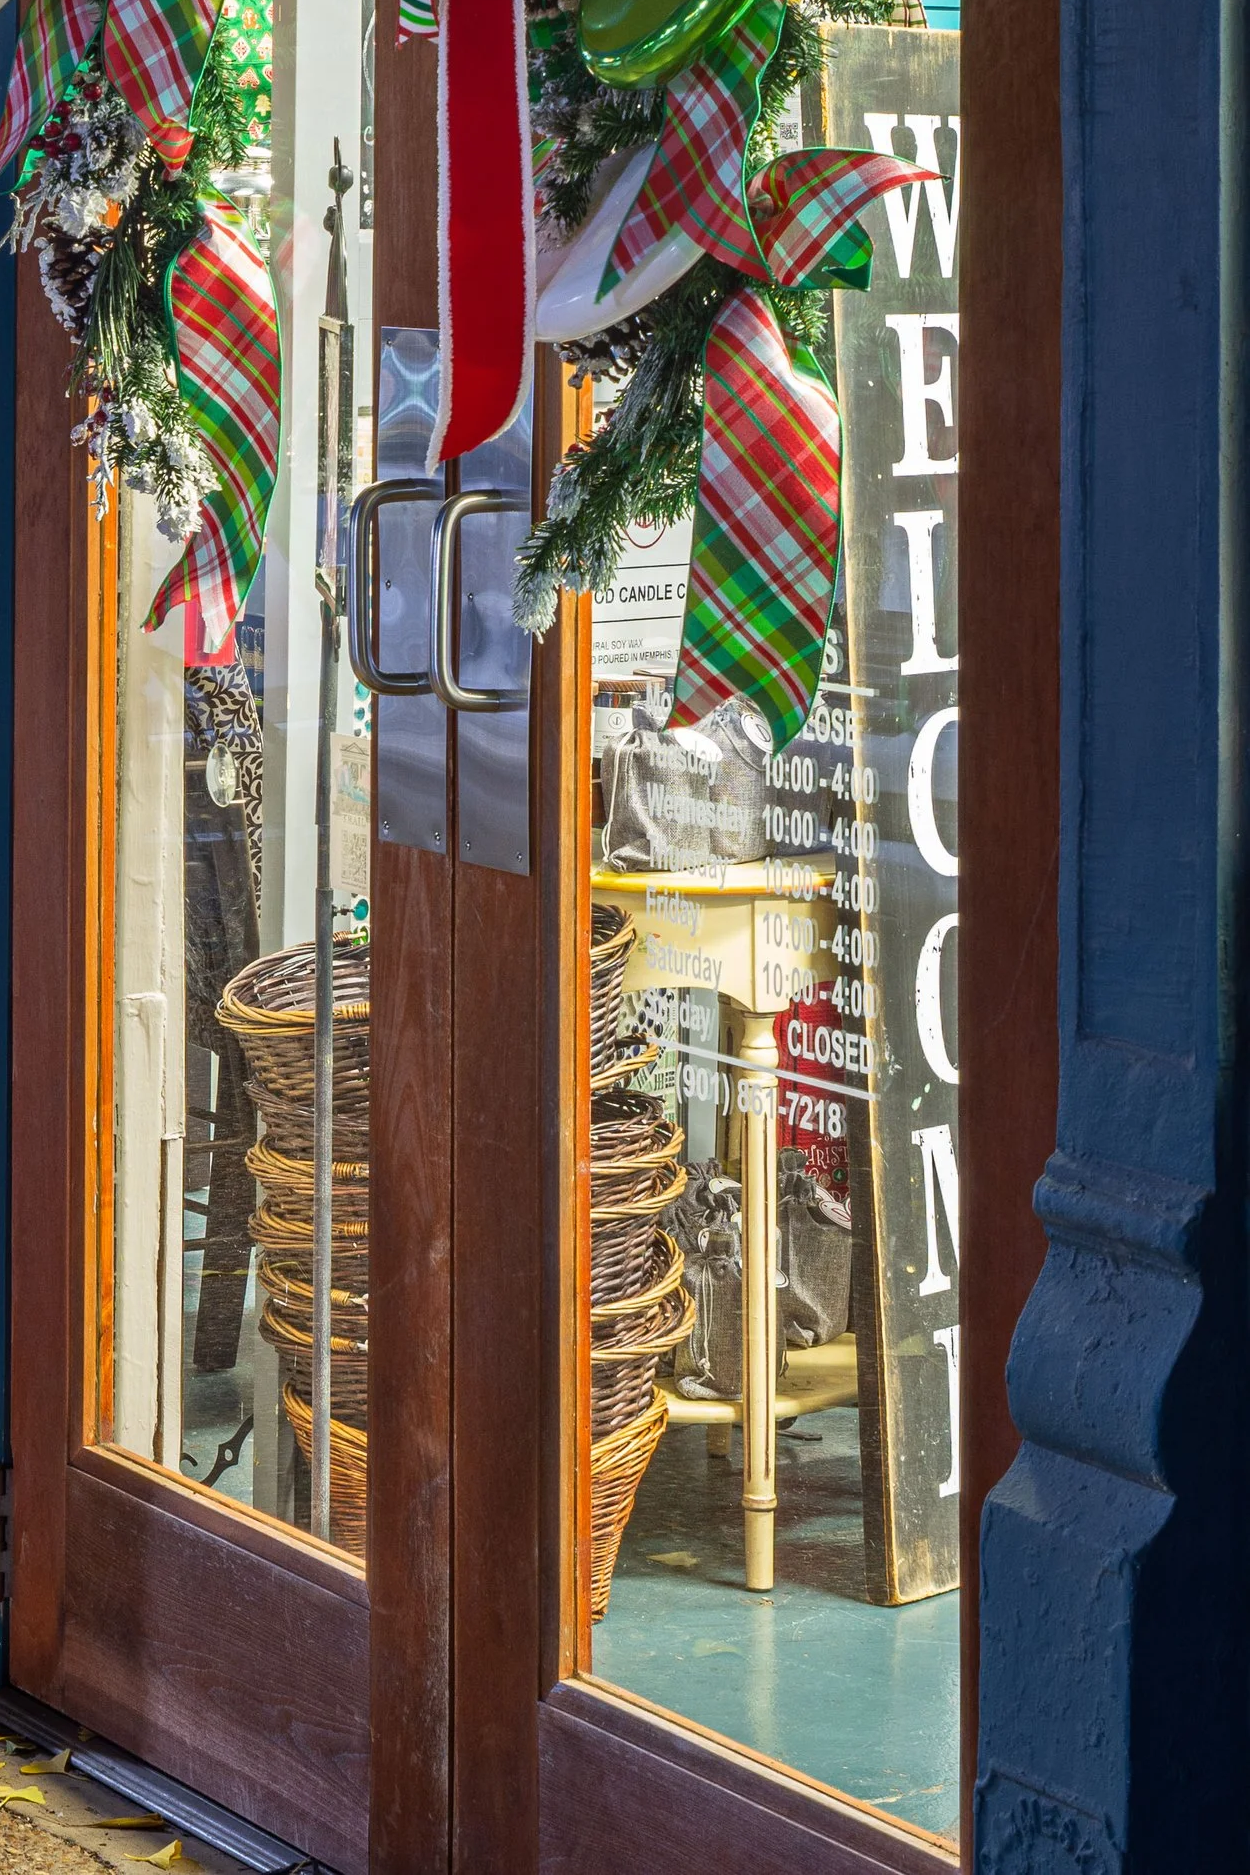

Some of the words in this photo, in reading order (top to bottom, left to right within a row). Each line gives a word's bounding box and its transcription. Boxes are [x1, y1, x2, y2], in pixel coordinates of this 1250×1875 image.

[619, 584, 672, 603] CANDLE
[598, 653, 630, 665] POURED
[631, 651, 638, 662] IN
[611, 639, 627, 650] SOY
[762, 753, 813, 794] 10:00
[832, 762, 874, 804] 4:00
[646, 781, 748, 843] Wednesday
[762, 805, 813, 848] 10:00
[832, 817, 874, 861] 4:00
[762, 857, 813, 902] 10:00
[832, 871, 874, 914] 4:00
[646, 885, 700, 936] Friday
[762, 911, 813, 954] 10:00
[832, 925, 874, 968] 4:00
[646, 933, 722, 992] Saturday
[762, 961, 813, 1005] 10:00
[832, 976, 874, 1019] 4:00
[787, 1020, 873, 1075] CLOSED
[676, 1062, 730, 1116] (901)
[737, 1077, 842, 1138] 861-7218
